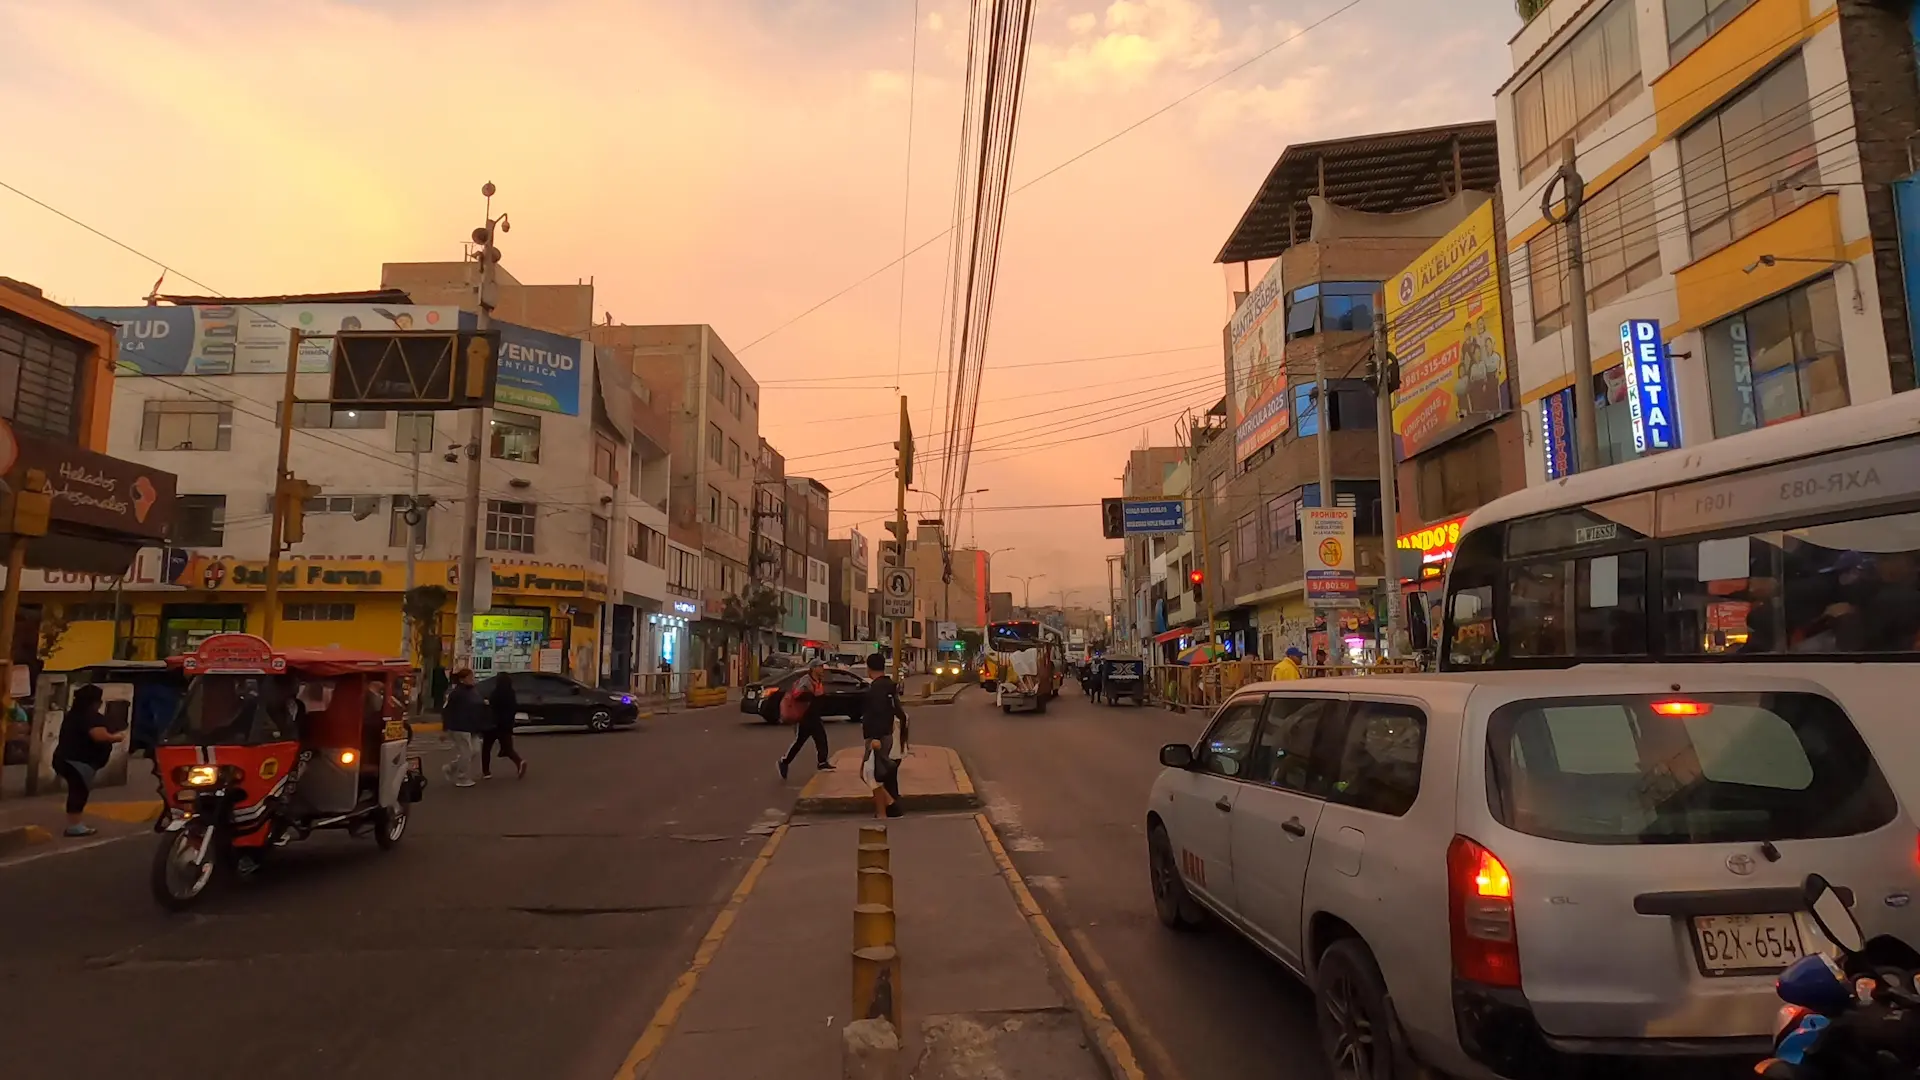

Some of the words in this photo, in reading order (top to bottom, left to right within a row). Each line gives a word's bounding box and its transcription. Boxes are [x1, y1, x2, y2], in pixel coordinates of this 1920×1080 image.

[1421, 234, 1478, 289] ALELUYA
[1232, 309, 1254, 345] SANTA
[1254, 278, 1280, 318] ISABEL
[1621, 325, 1643, 449] BRACKETS
[1636, 322, 1668, 448] DENTAL
[1267, 393, 1284, 417] 2025
[60, 462, 117, 492] Helados
[42, 479, 129, 515] Artesanales
[1310, 511, 1348, 519] PROHIBIDO
[307, 566, 382, 585] Farma
[1702, 926, 1797, 961] B2X-654
